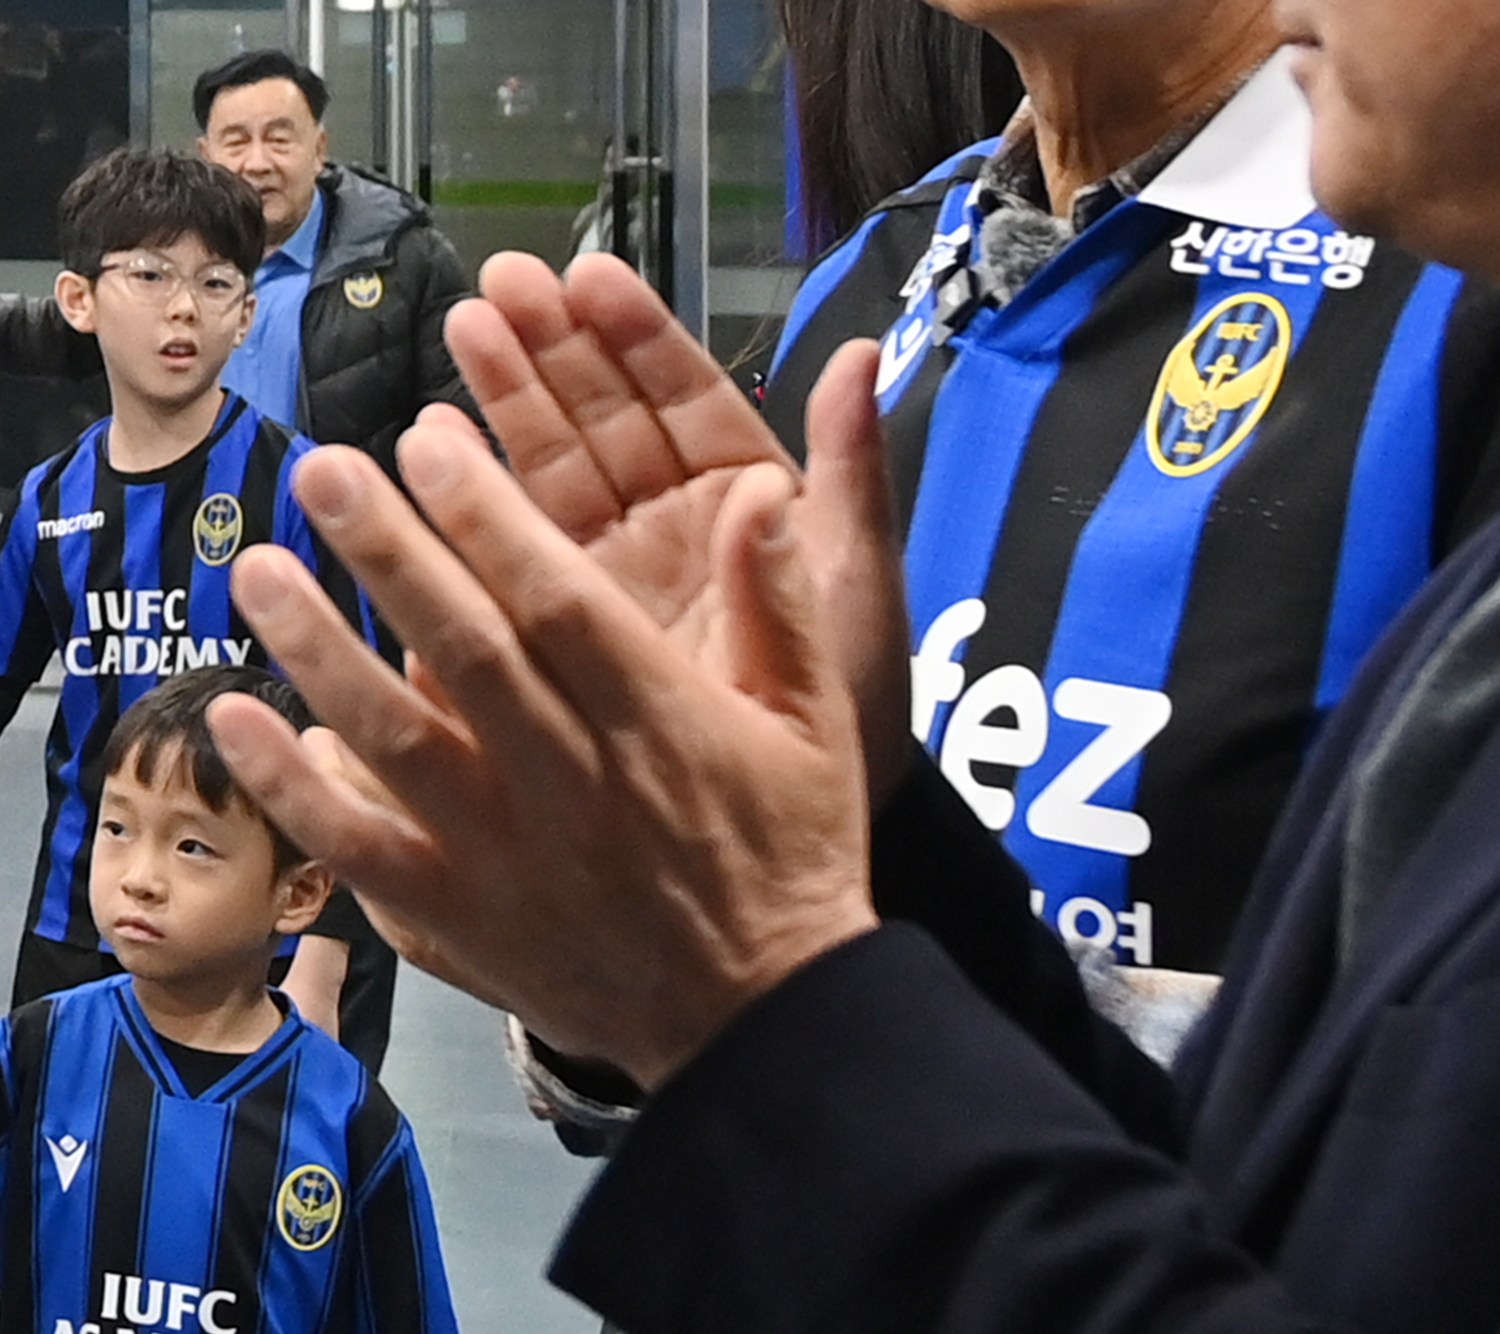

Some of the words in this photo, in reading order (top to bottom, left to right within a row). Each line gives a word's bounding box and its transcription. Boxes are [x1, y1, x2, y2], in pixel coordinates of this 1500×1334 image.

[1170, 221, 1376, 290] 신한은행
[37, 510, 105, 540] macron
[86, 588, 188, 632] IUFC
[64, 633, 252, 678] CADEMY
[910, 598, 1173, 857] fez
